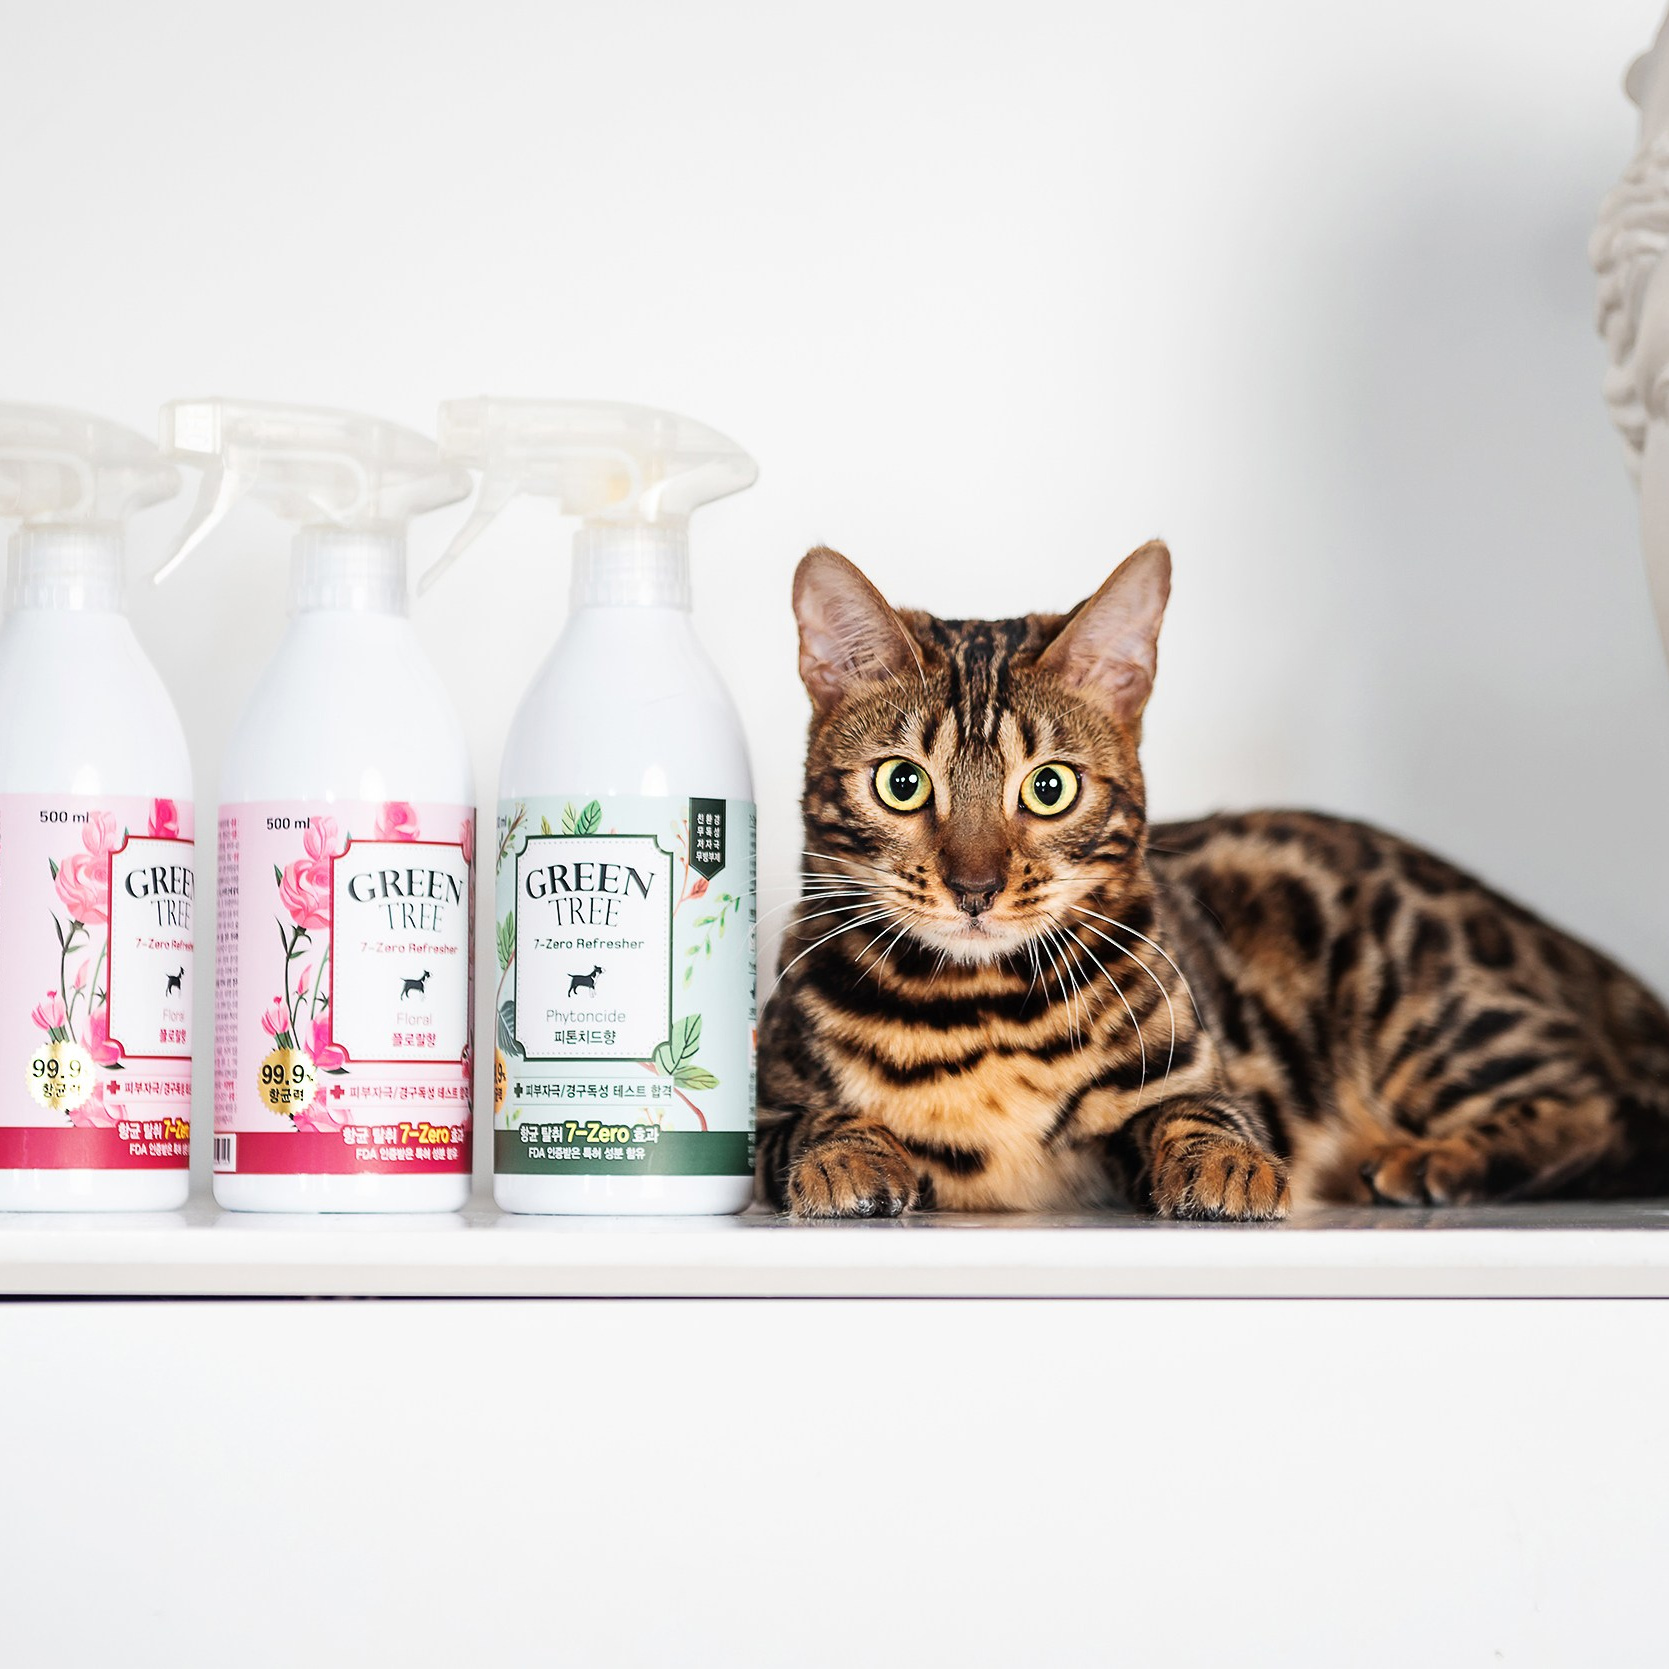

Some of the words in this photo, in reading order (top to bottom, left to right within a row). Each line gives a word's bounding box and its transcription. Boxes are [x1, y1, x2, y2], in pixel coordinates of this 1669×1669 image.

[39, 811, 68, 823] 500
[72, 811, 90, 823] ml
[266, 817, 291, 830] 500
[294, 817, 311, 829] ml
[348, 868, 464, 906] GREEN
[525, 862, 655, 900] GREEN
[150, 899, 191, 931] TREE
[378, 902, 445, 933] TREE
[548, 897, 621, 927] TREE
[135, 938, 170, 951] 7-Zero
[360, 942, 405, 953] 7-Zero
[534, 939, 573, 950] 7-Zero
[576, 939, 645, 950] Refresher
[396, 1012, 433, 1026] Floral
[546, 1009, 627, 1024] Phytoncide
[554, 1030, 617, 1045] 피톤치드향
[525, 1084, 609, 1099] 피부자극/경구독성
[613, 1084, 647, 1098] 테스트
[399, 1123, 450, 1145] 7-Zero
[519, 1125, 539, 1143] 항균
[565, 1122, 630, 1144] 7-Zero
[631, 1126, 660, 1144] 효과
[129, 1143, 148, 1156] FDA
[355, 1148, 377, 1161] FDA
[528, 1147, 546, 1159] FDA
